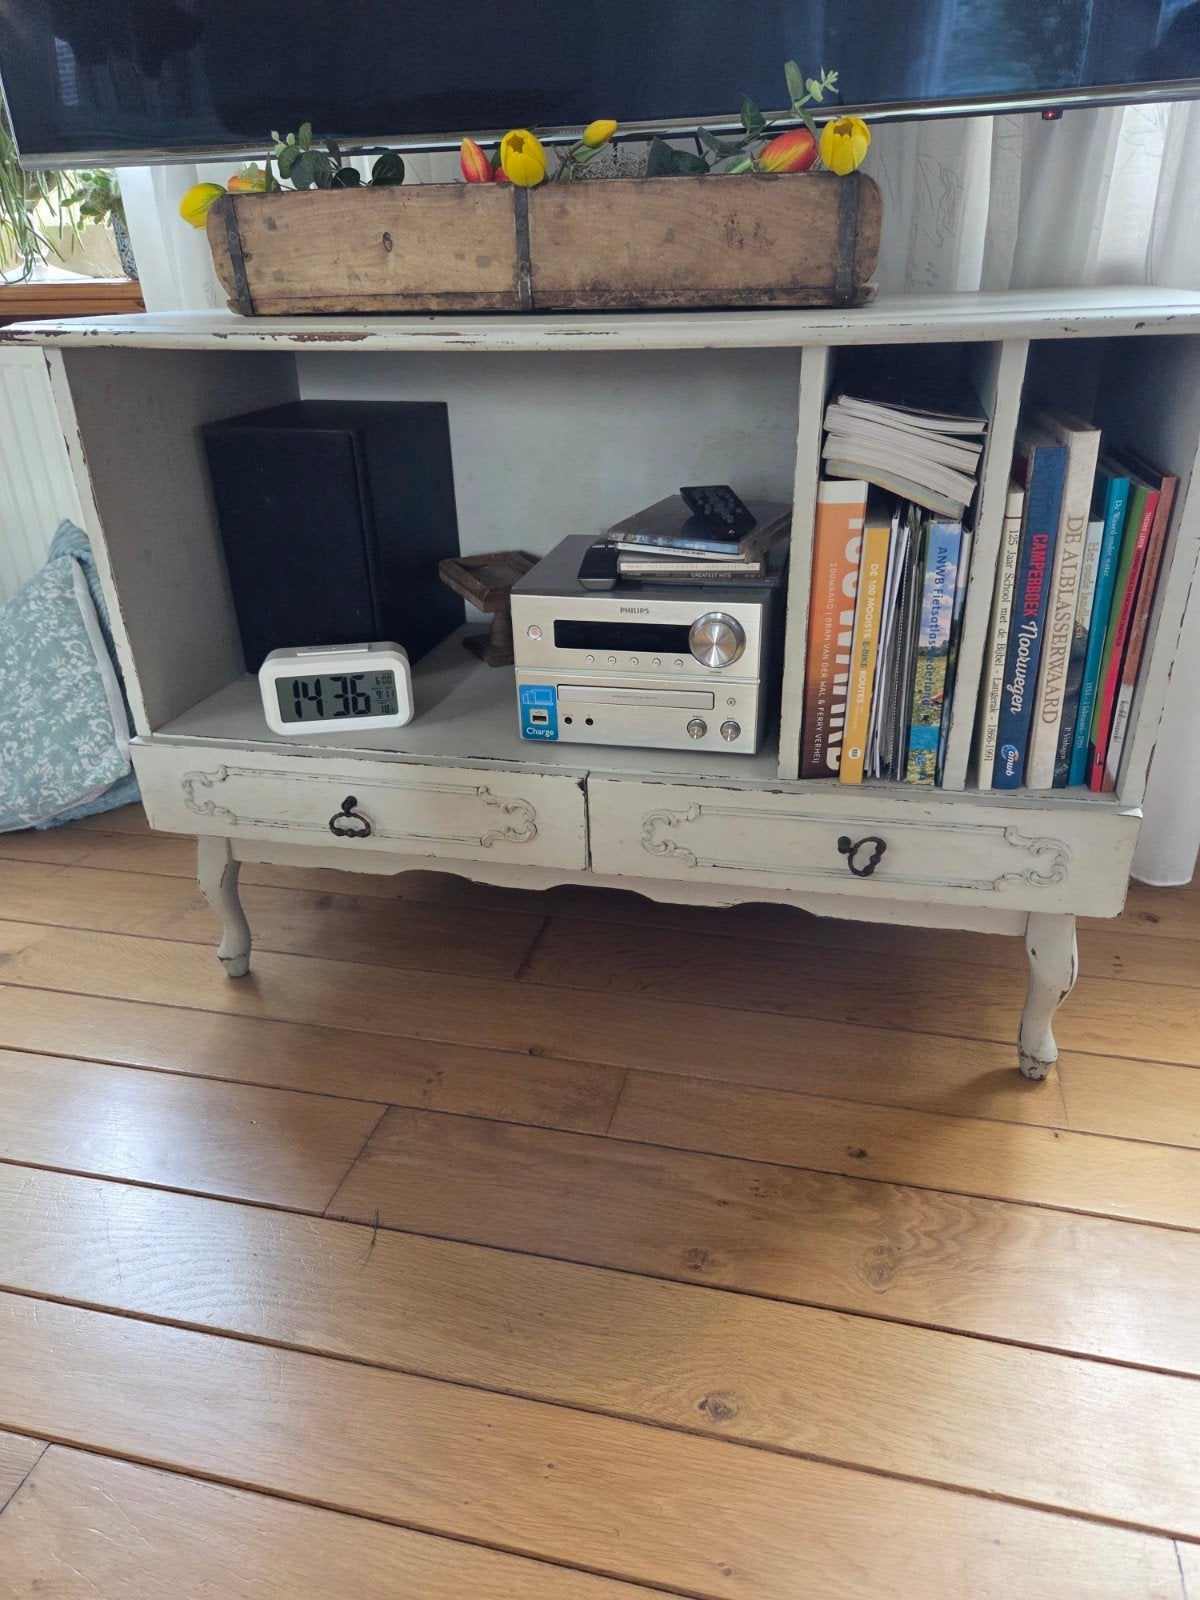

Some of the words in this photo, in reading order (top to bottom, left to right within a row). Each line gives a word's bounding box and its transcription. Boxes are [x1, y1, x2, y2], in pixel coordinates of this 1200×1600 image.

[1114, 500, 1122, 510] De
[1065, 514, 1084, 545] DE
[1109, 511, 1120, 534] Waard
[1008, 530, 1018, 545] 125
[1106, 536, 1116, 556] onder
[869, 563, 878, 576] DE
[934, 547, 948, 585] ANWB
[1005, 551, 1016, 568] Jaar
[1103, 558, 1111, 576] water
[1023, 534, 1049, 616] CAMPERBOEK
[867, 579, 876, 595] 100
[1001, 573, 1013, 602] School
[862, 597, 874, 638] MOOISTE
[928, 589, 943, 645] Fietsatlas
[999, 608, 1009, 623] met
[822, 617, 832, 640] BRAM
[997, 629, 1007, 638] de
[1042, 550, 1078, 724] ALBLASSERWAARD
[822, 643, 830, 657] VAN
[859, 641, 870, 668] E-BIKE
[993, 643, 1004, 666] Bijbel
[820, 662, 828, 678] DER
[1006, 621, 1038, 714] Noorwegen
[818, 680, 827, 696] WAL
[856, 670, 867, 704] ROUTES
[989, 677, 1001, 713] Langerak
[815, 707, 824, 730] FERRY
[526, 727, 554, 737] Charge
[984, 724, 996, 761] 1866-1991
[1005, 751, 1017, 776] anwb
